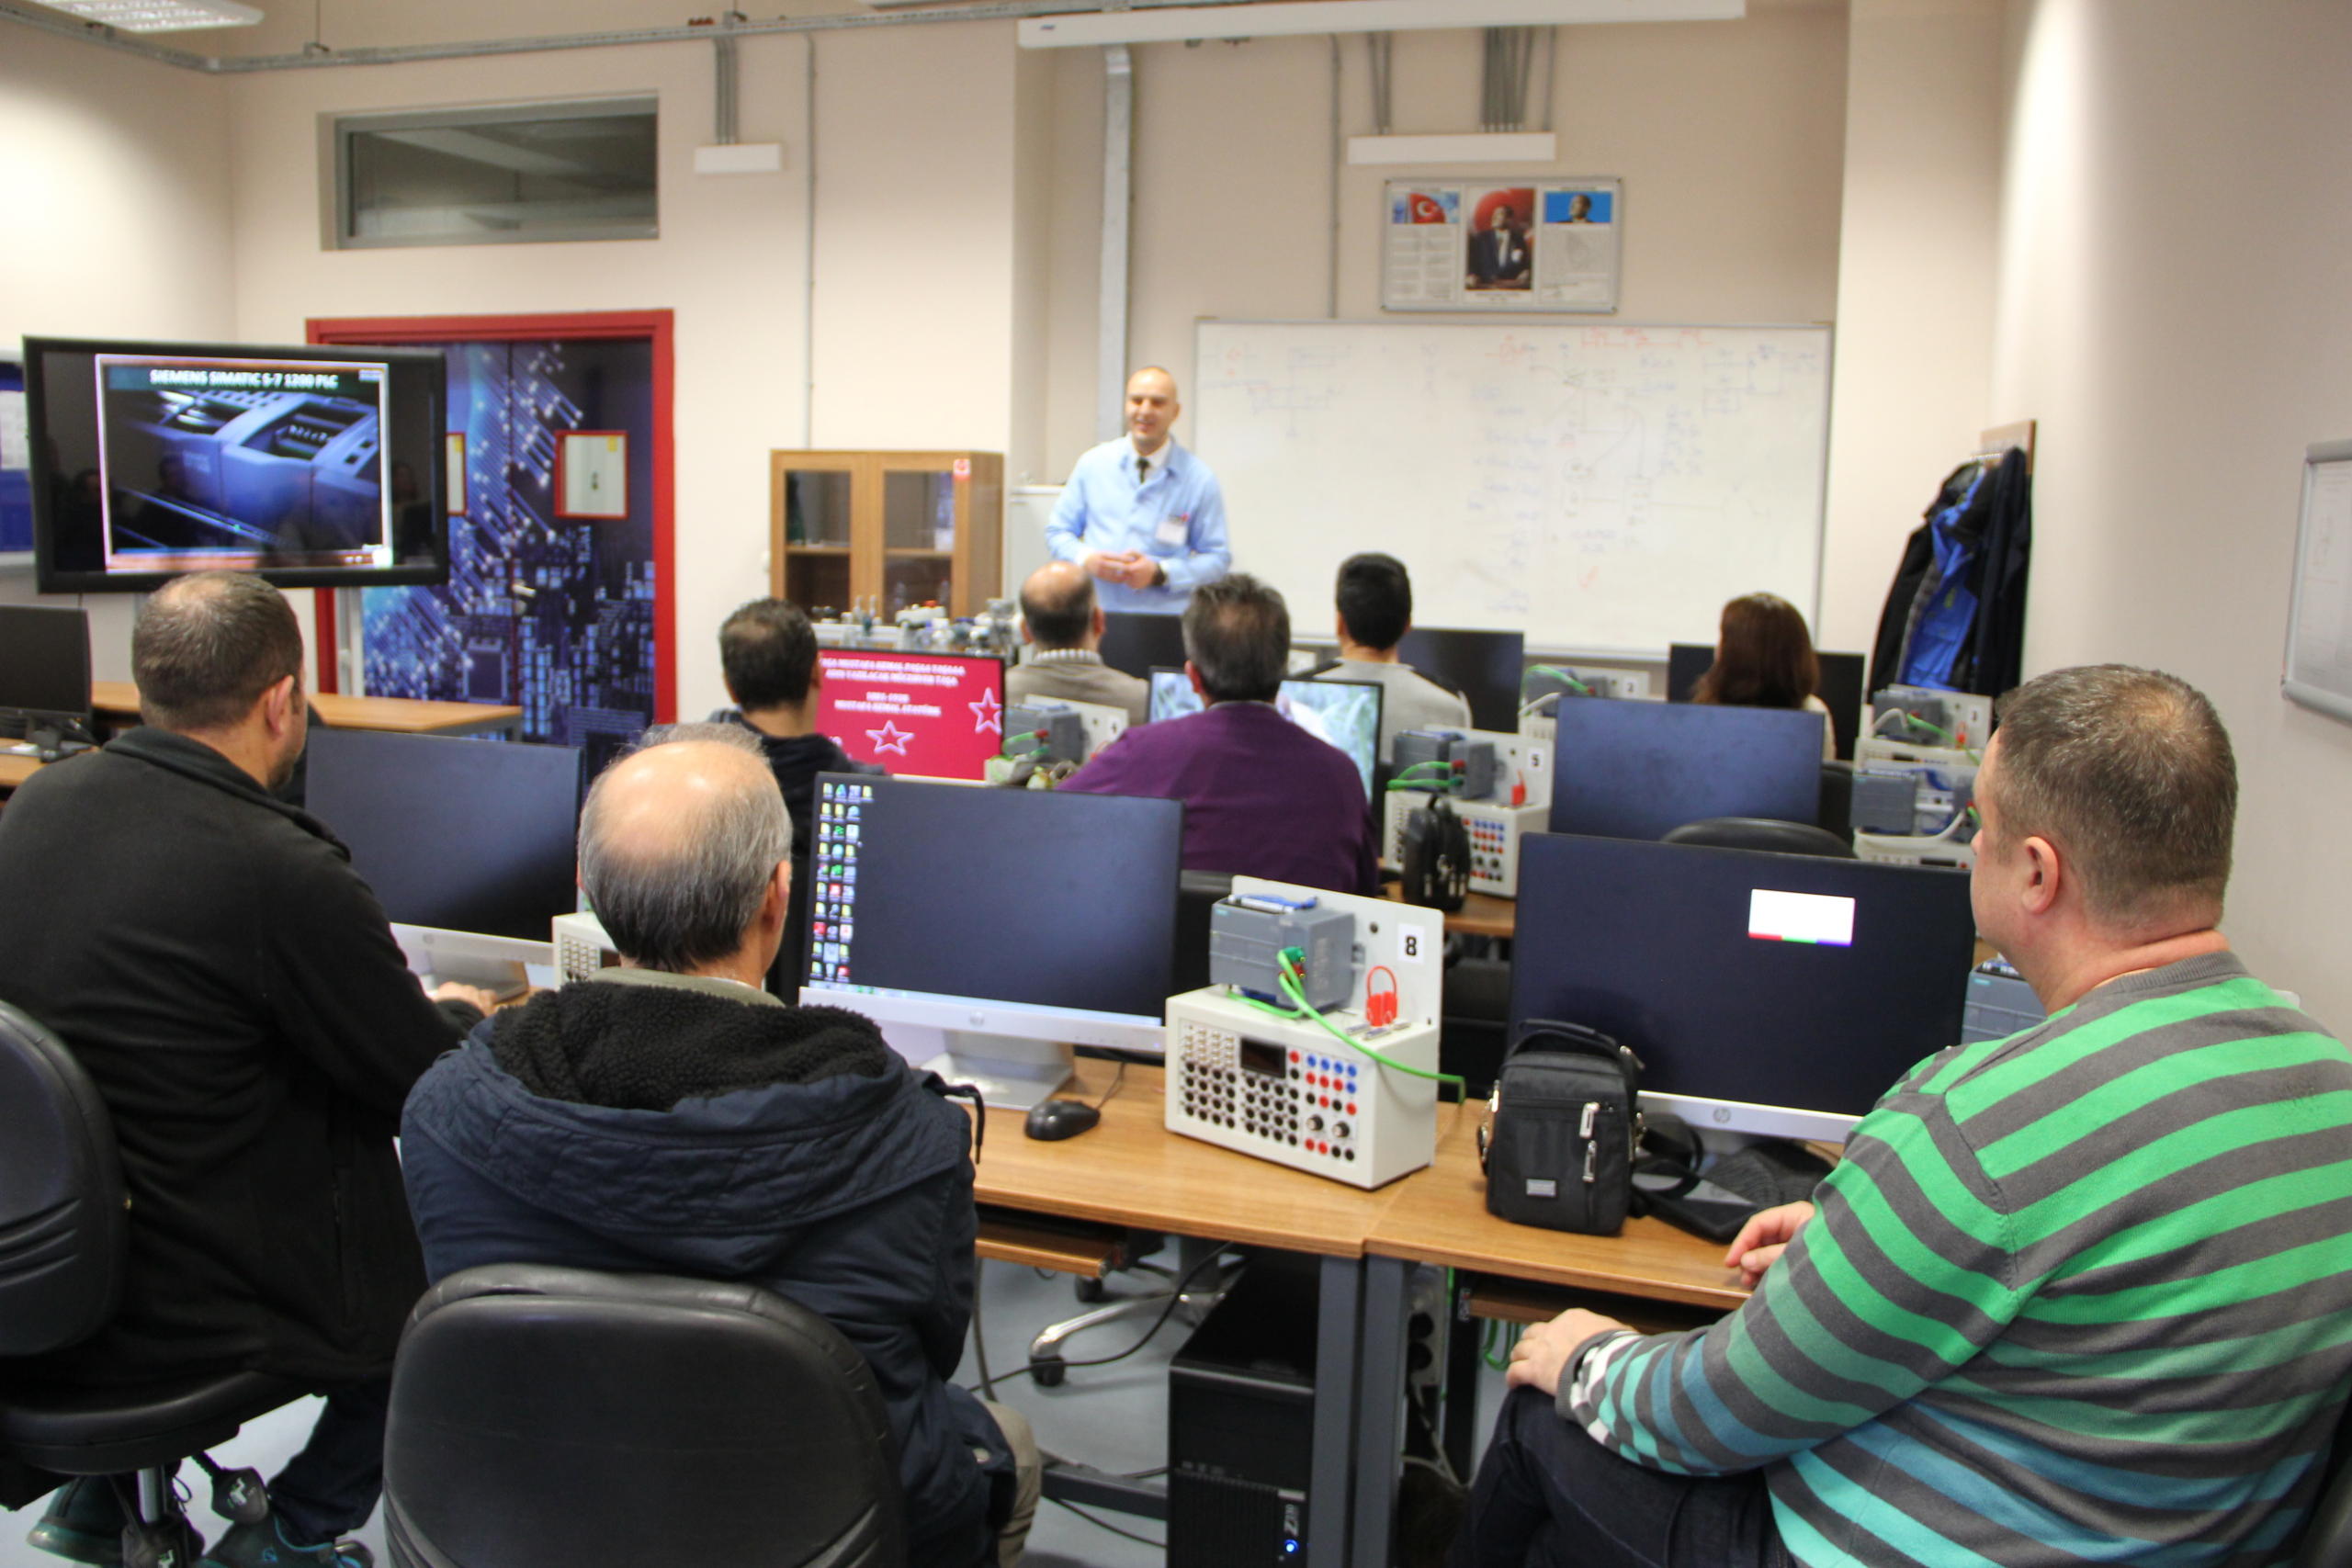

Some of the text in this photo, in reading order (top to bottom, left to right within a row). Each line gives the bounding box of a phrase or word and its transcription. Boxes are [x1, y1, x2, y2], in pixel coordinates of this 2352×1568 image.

[150, 369, 339, 389] SIEMENS SIMATIC S-7 1200 PLC
[1406, 935, 1417, 956] 8
